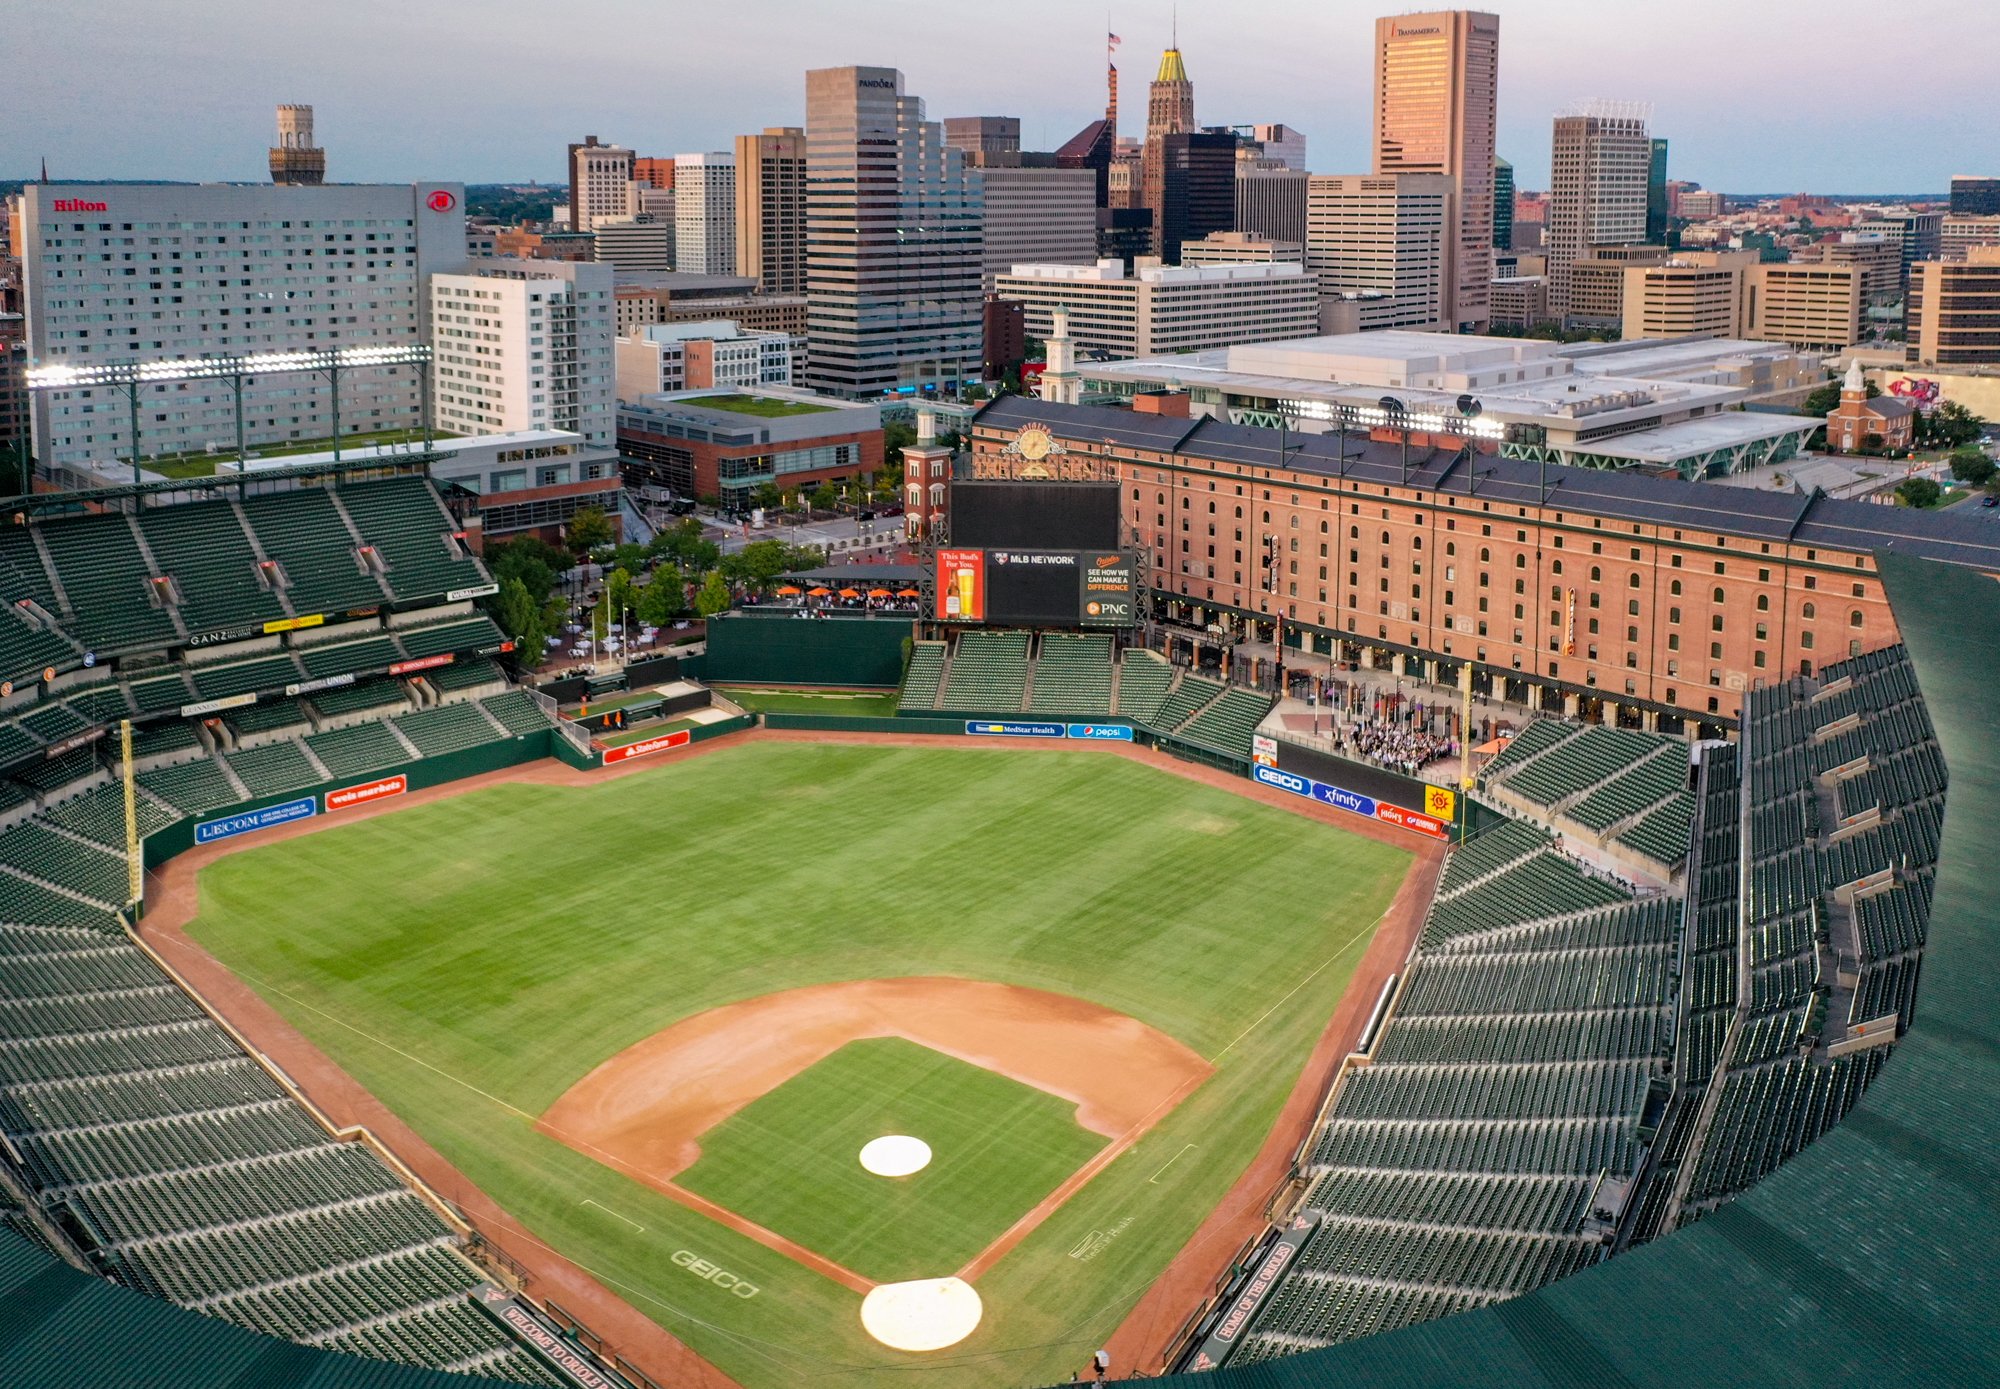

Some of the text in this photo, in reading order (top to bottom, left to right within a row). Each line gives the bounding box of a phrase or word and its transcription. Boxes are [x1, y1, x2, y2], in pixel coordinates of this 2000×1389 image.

[54, 197, 107, 211] Hilton
[942, 552, 978, 560] This Bud's
[1010, 555, 1075, 564] MLB NETWORK
[1101, 603, 1128, 615] PNC
[190, 631, 228, 646] GANZ
[326, 673, 353, 686] UNION
[1033, 726, 1055, 734] Health
[1096, 728, 1121, 737] pepsi
[1259, 768, 1303, 791] GEICO
[332, 781, 401, 804] weis markets
[1325, 788, 1362, 811] xfinity
[1381, 808, 1402, 824] HIGH'S
[670, 1250, 760, 1299] GEICO
[1219, 1245, 1291, 1339] HOME OF THE ORIOLES
[505, 1308, 600, 1389] WELCOME TO ORIOLE
